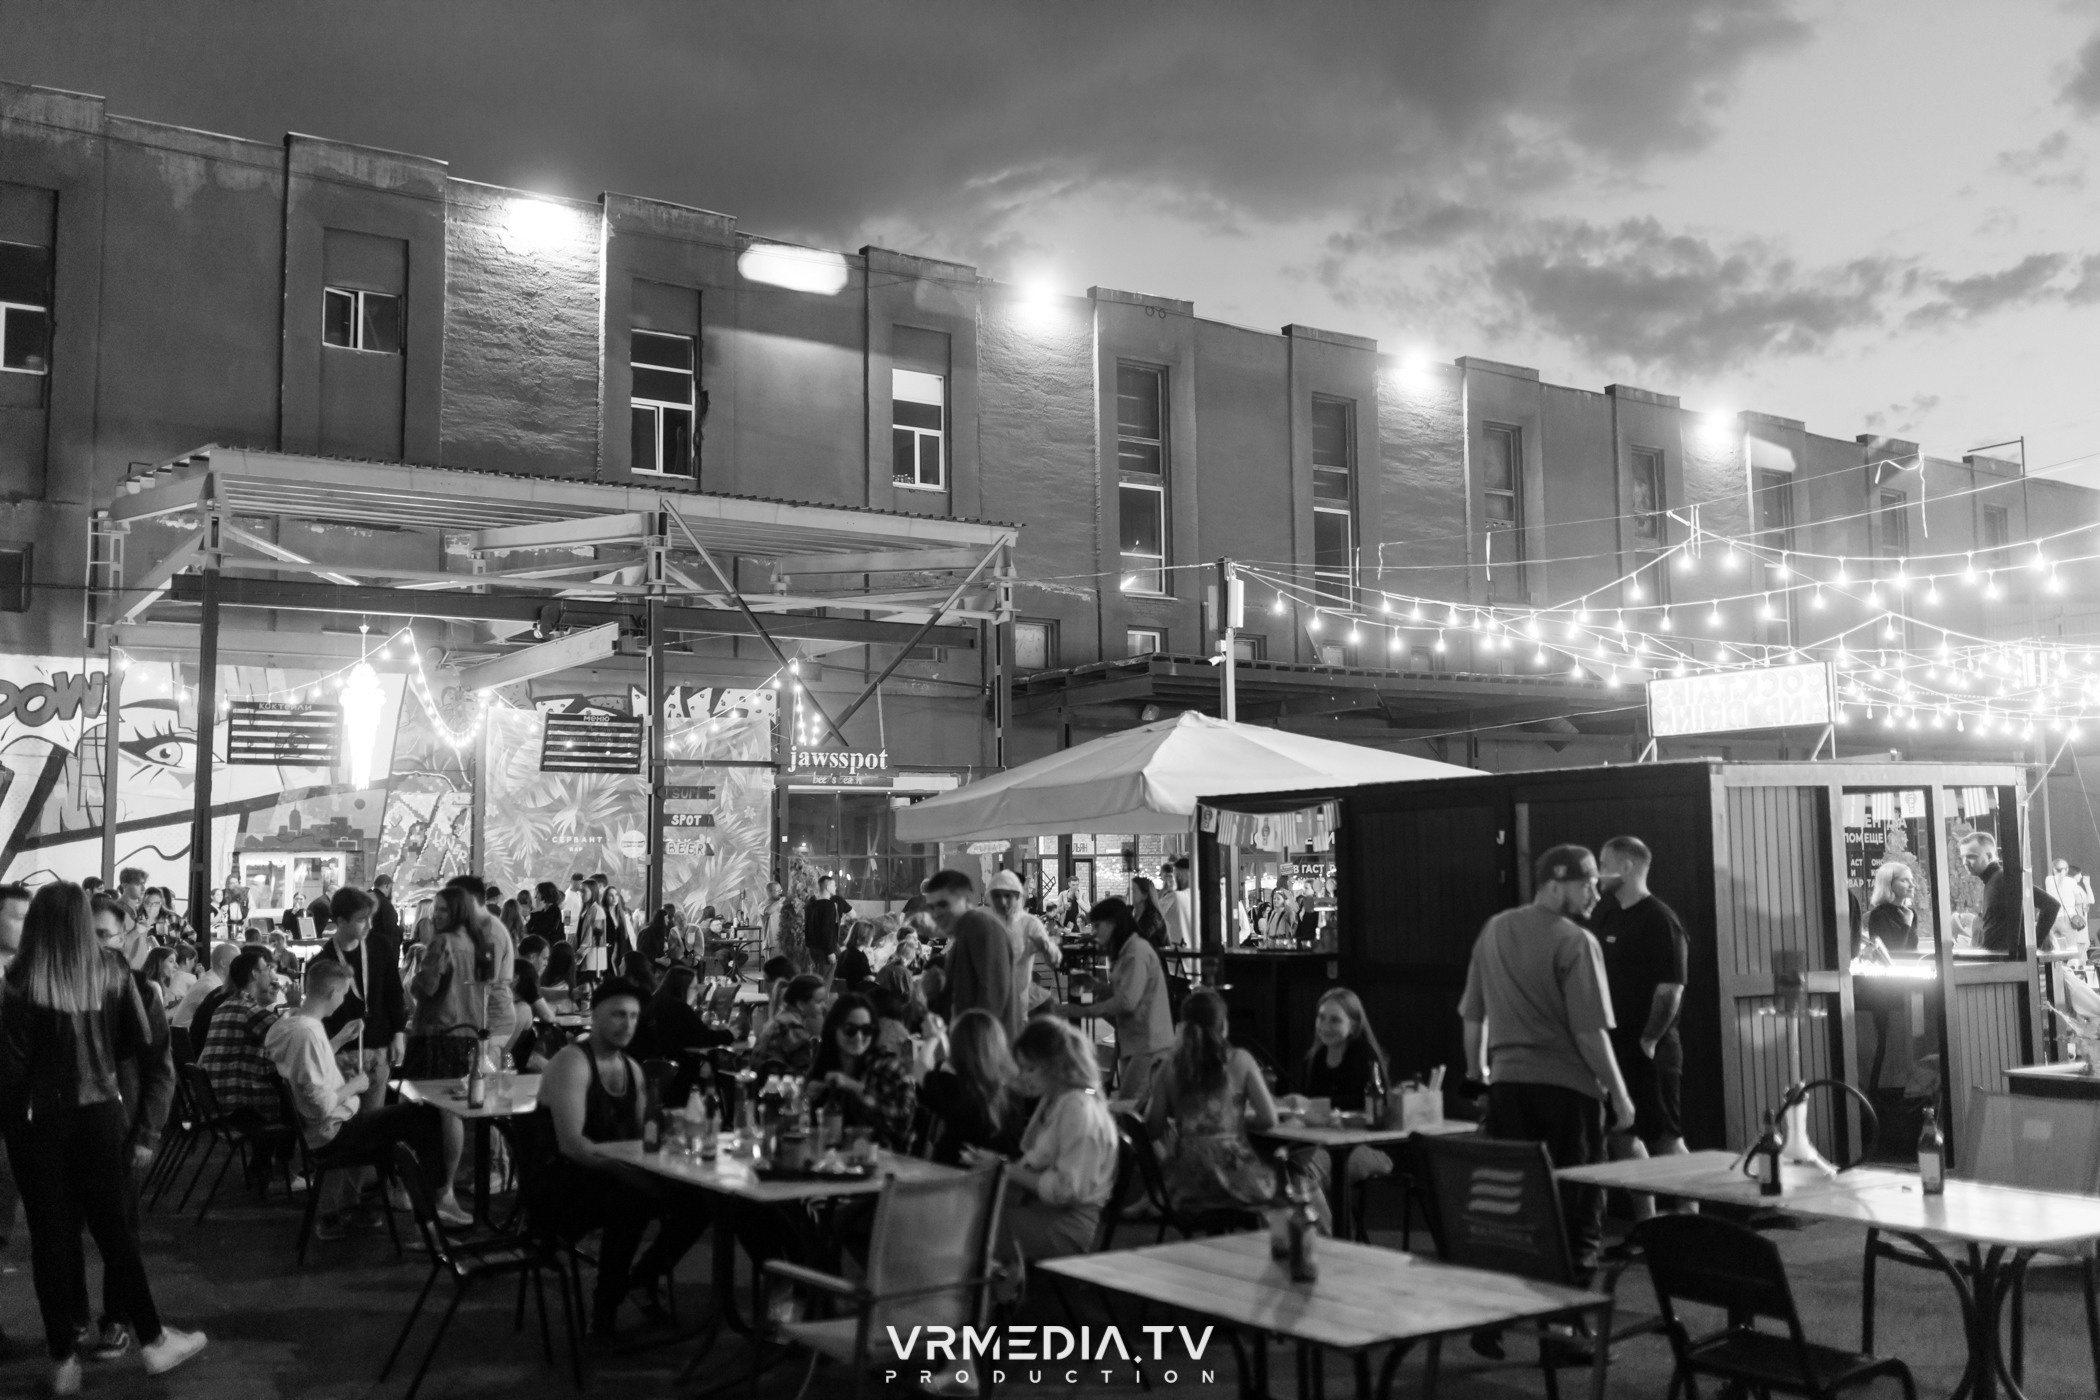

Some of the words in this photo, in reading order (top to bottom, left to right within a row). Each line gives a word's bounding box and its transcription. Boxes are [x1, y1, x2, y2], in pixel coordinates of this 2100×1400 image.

[787, 745, 888, 775] jawsspot
[839, 771, 862, 785] eah
[671, 814, 702, 826] SPOT
[668, 843, 704, 855] BEER
